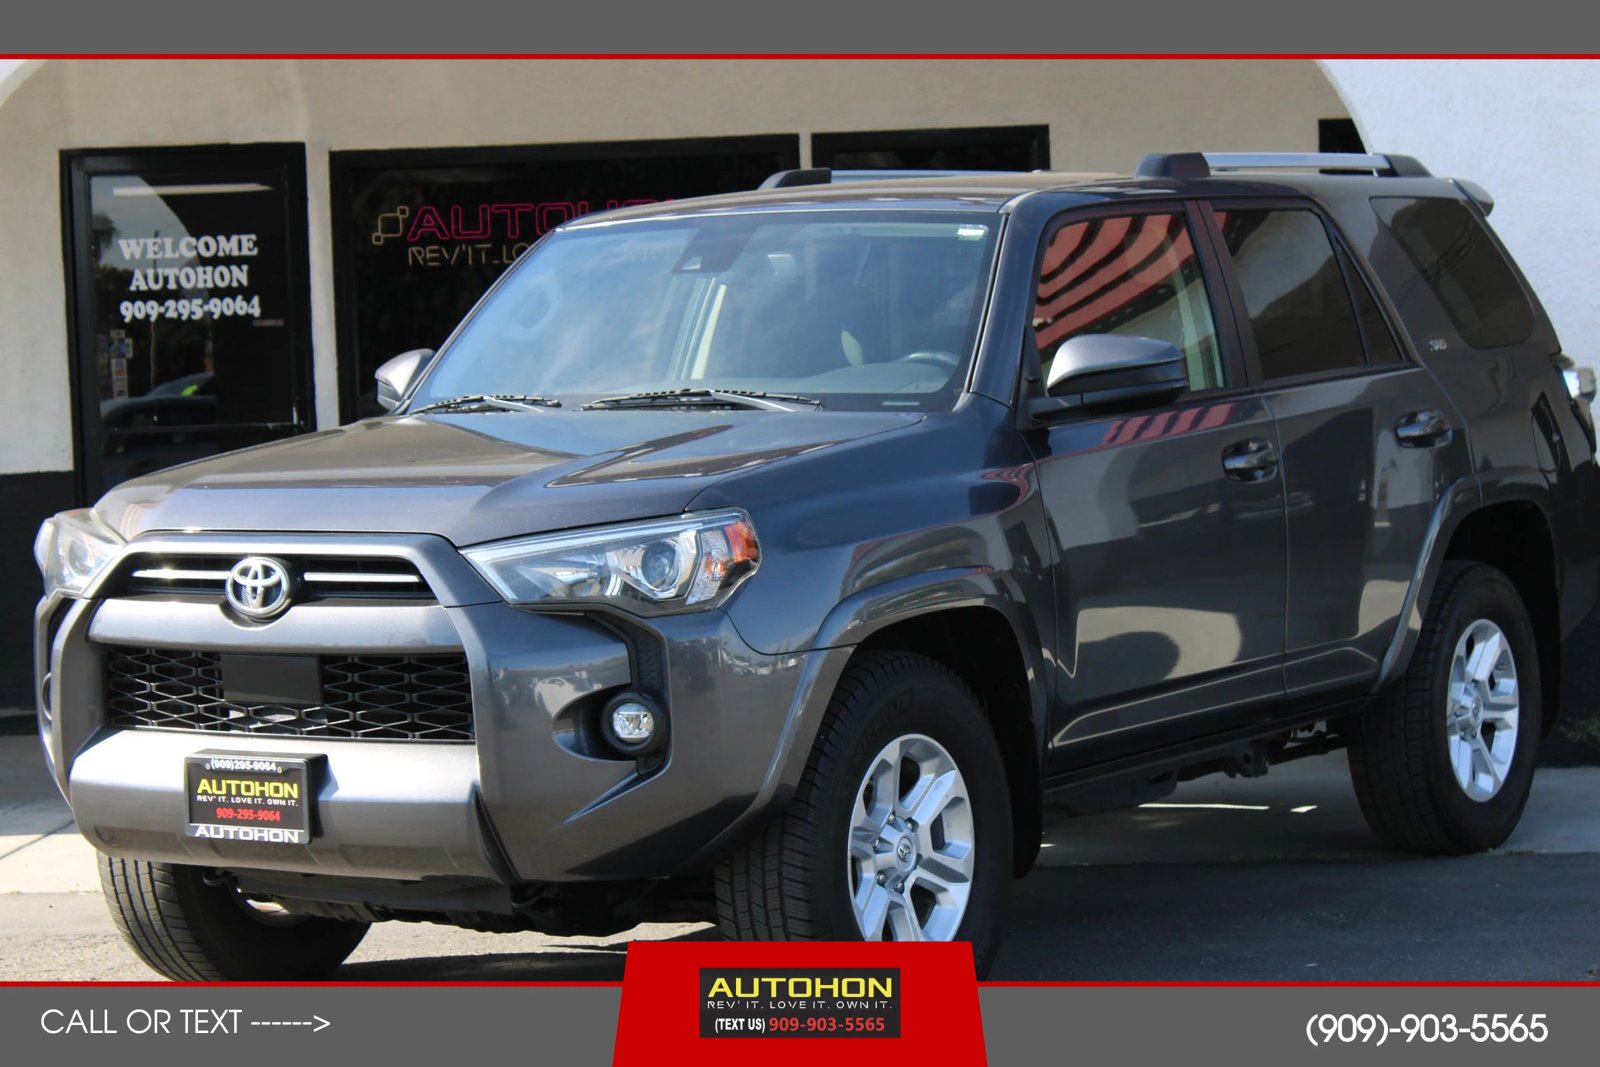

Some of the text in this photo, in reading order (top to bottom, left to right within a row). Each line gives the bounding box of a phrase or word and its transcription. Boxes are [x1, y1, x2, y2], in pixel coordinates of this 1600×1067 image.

[118, 233, 259, 260] WELCOME
[129, 265, 249, 291] AUTOHON
[119, 295, 261, 323] 909-295-9064
[210, 758, 277, 772] (909)295-9064
[197, 778, 299, 799] AUTOHON
[231, 796, 251, 804] LOVE
[254, 797, 265, 805] IT.
[267, 798, 286, 806] OWN
[288, 799, 299, 807] IT.
[216, 807, 281, 821] 909-295-9064
[195, 825, 300, 844] AUTOHON
